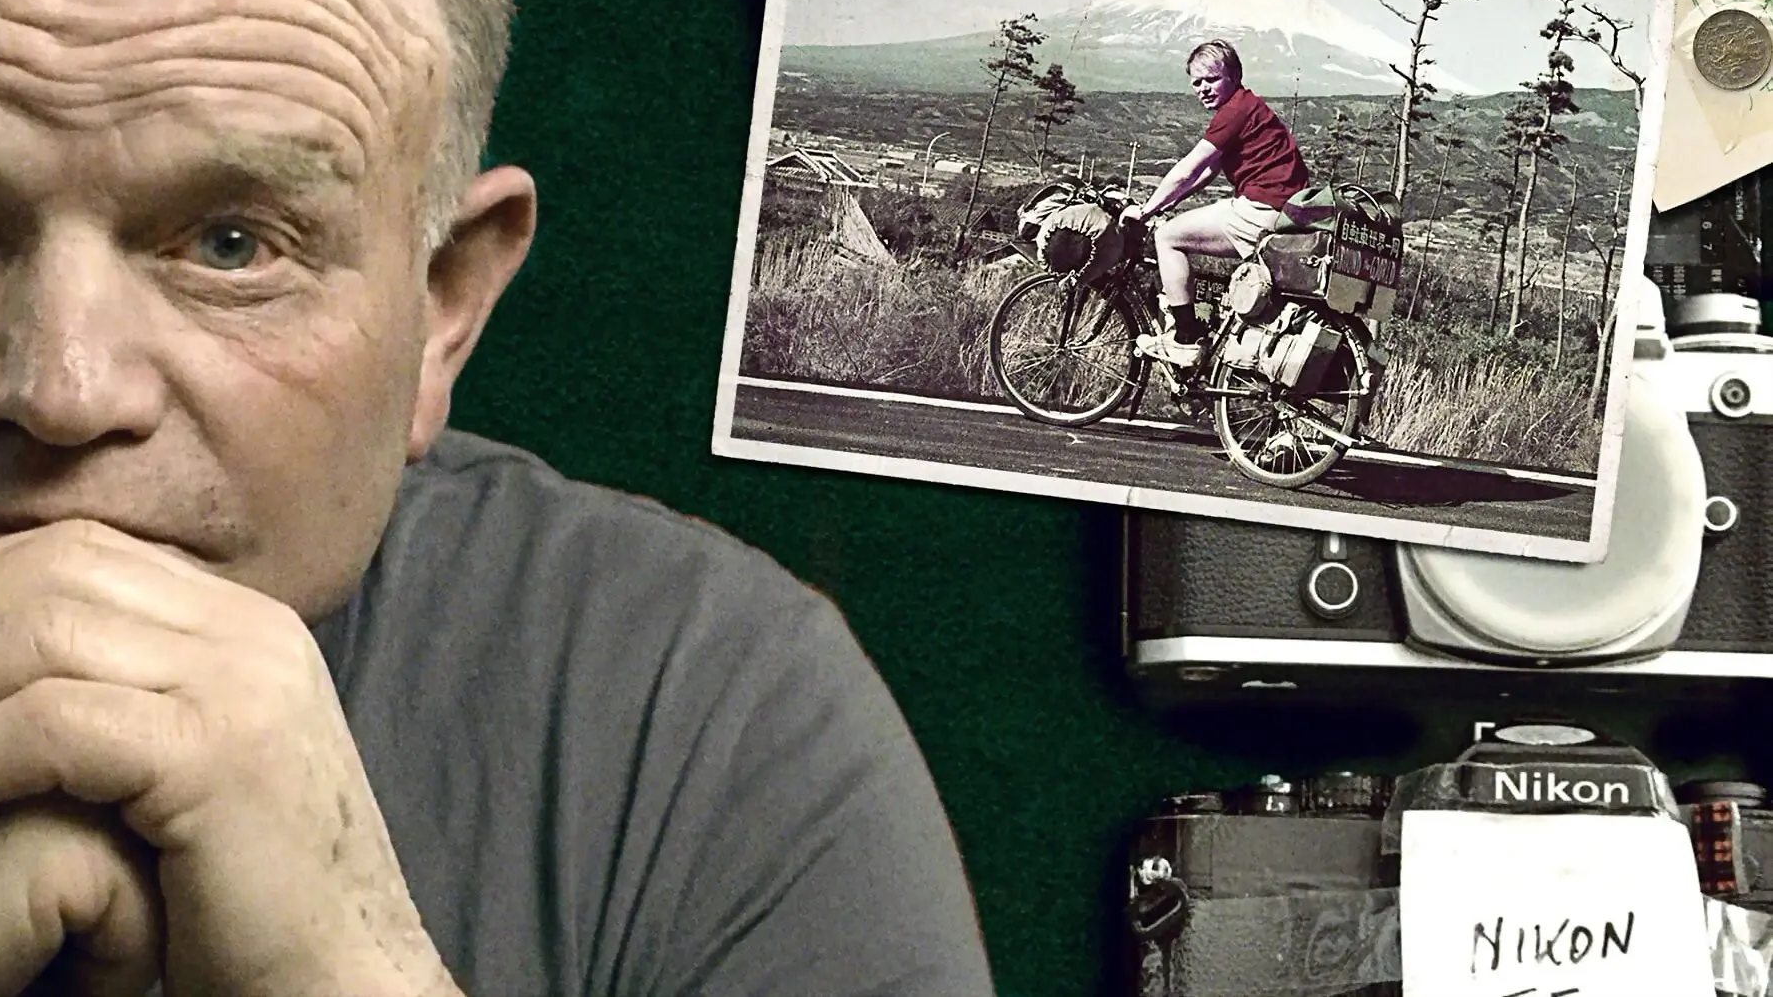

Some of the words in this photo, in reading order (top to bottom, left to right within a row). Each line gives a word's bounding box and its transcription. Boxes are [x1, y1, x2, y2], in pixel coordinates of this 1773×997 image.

[1702, 221, 1712, 229] 6
[1494, 770, 1629, 804] Nikon
[1471, 911, 1635, 974] NIKON
